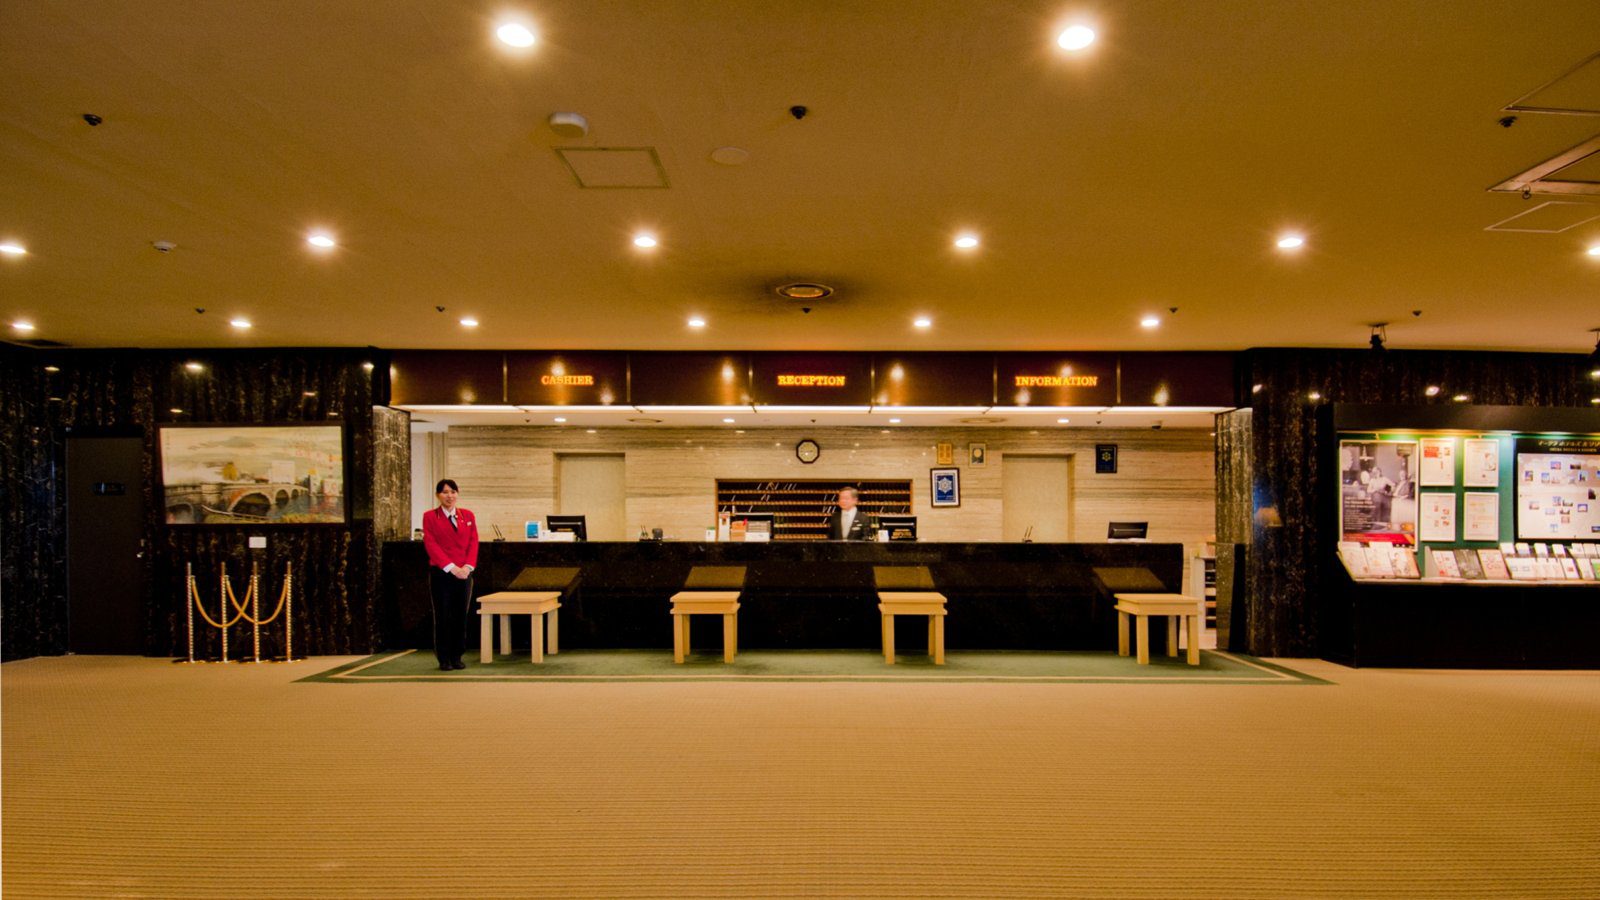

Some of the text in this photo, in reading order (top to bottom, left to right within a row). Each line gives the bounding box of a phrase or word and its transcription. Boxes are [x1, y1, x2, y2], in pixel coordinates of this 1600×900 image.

[541, 375, 594, 385] CASHIER
[777, 375, 846, 386] RECEPTION
[1015, 376, 1098, 386] INFORMATION
